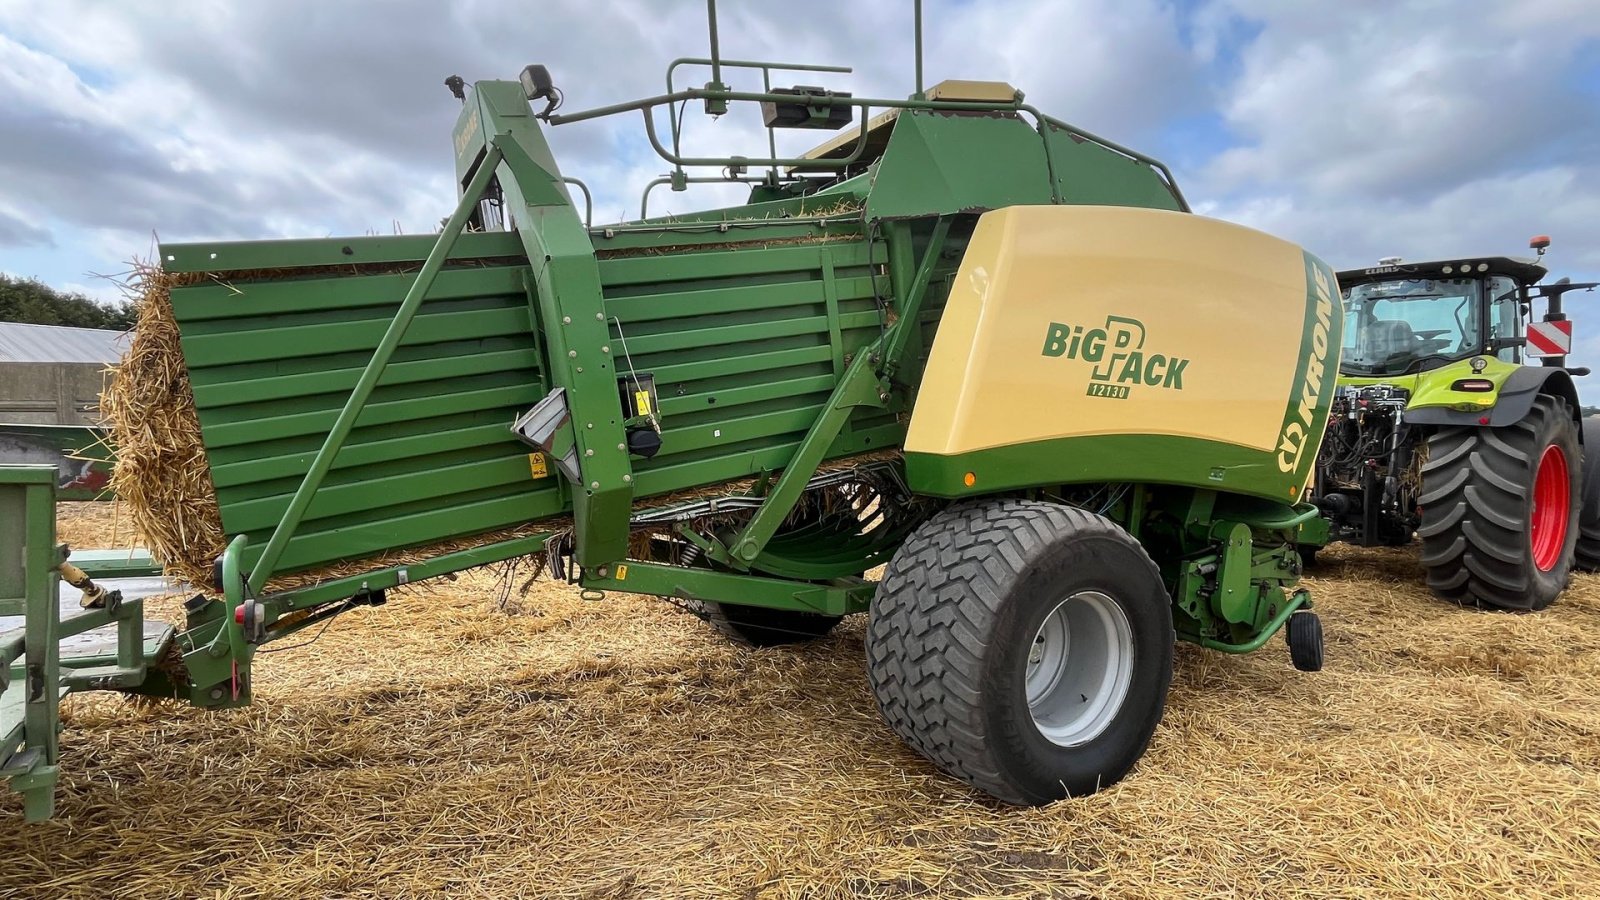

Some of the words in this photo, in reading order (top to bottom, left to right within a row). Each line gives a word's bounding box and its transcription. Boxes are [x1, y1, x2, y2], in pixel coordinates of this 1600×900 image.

[1364, 265, 1399, 275] CLAAS
[1091, 315, 1189, 390] PACK
[1298, 262, 1332, 428] KRONE
[1092, 384, 1126, 398] 12130
